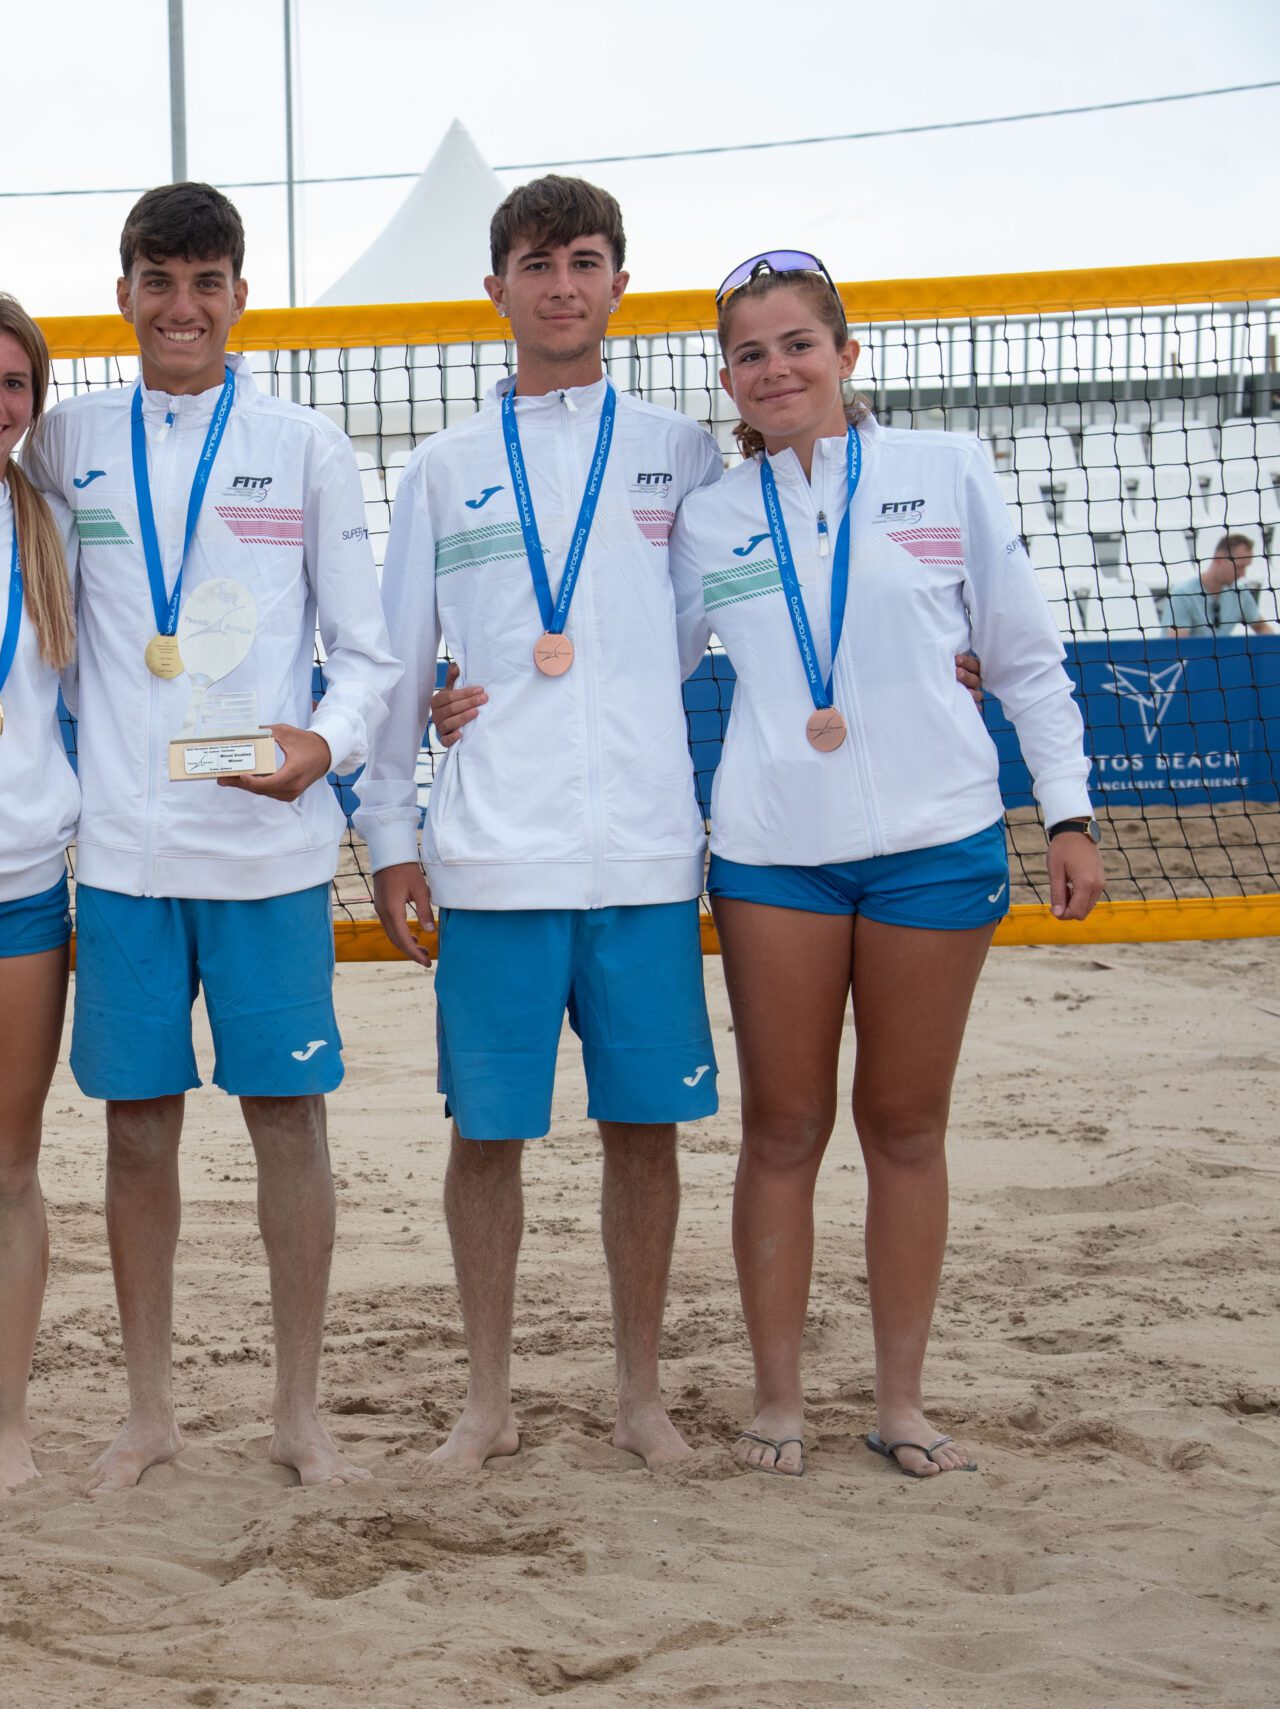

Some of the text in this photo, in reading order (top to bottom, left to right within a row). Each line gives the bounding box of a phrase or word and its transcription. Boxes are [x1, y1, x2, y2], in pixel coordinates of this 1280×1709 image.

[232, 476, 273, 489] FITP
[637, 473, 673, 485] FITP
[881, 498, 926, 514] FITP
[1093, 750, 1240, 772] TOS BEACH
